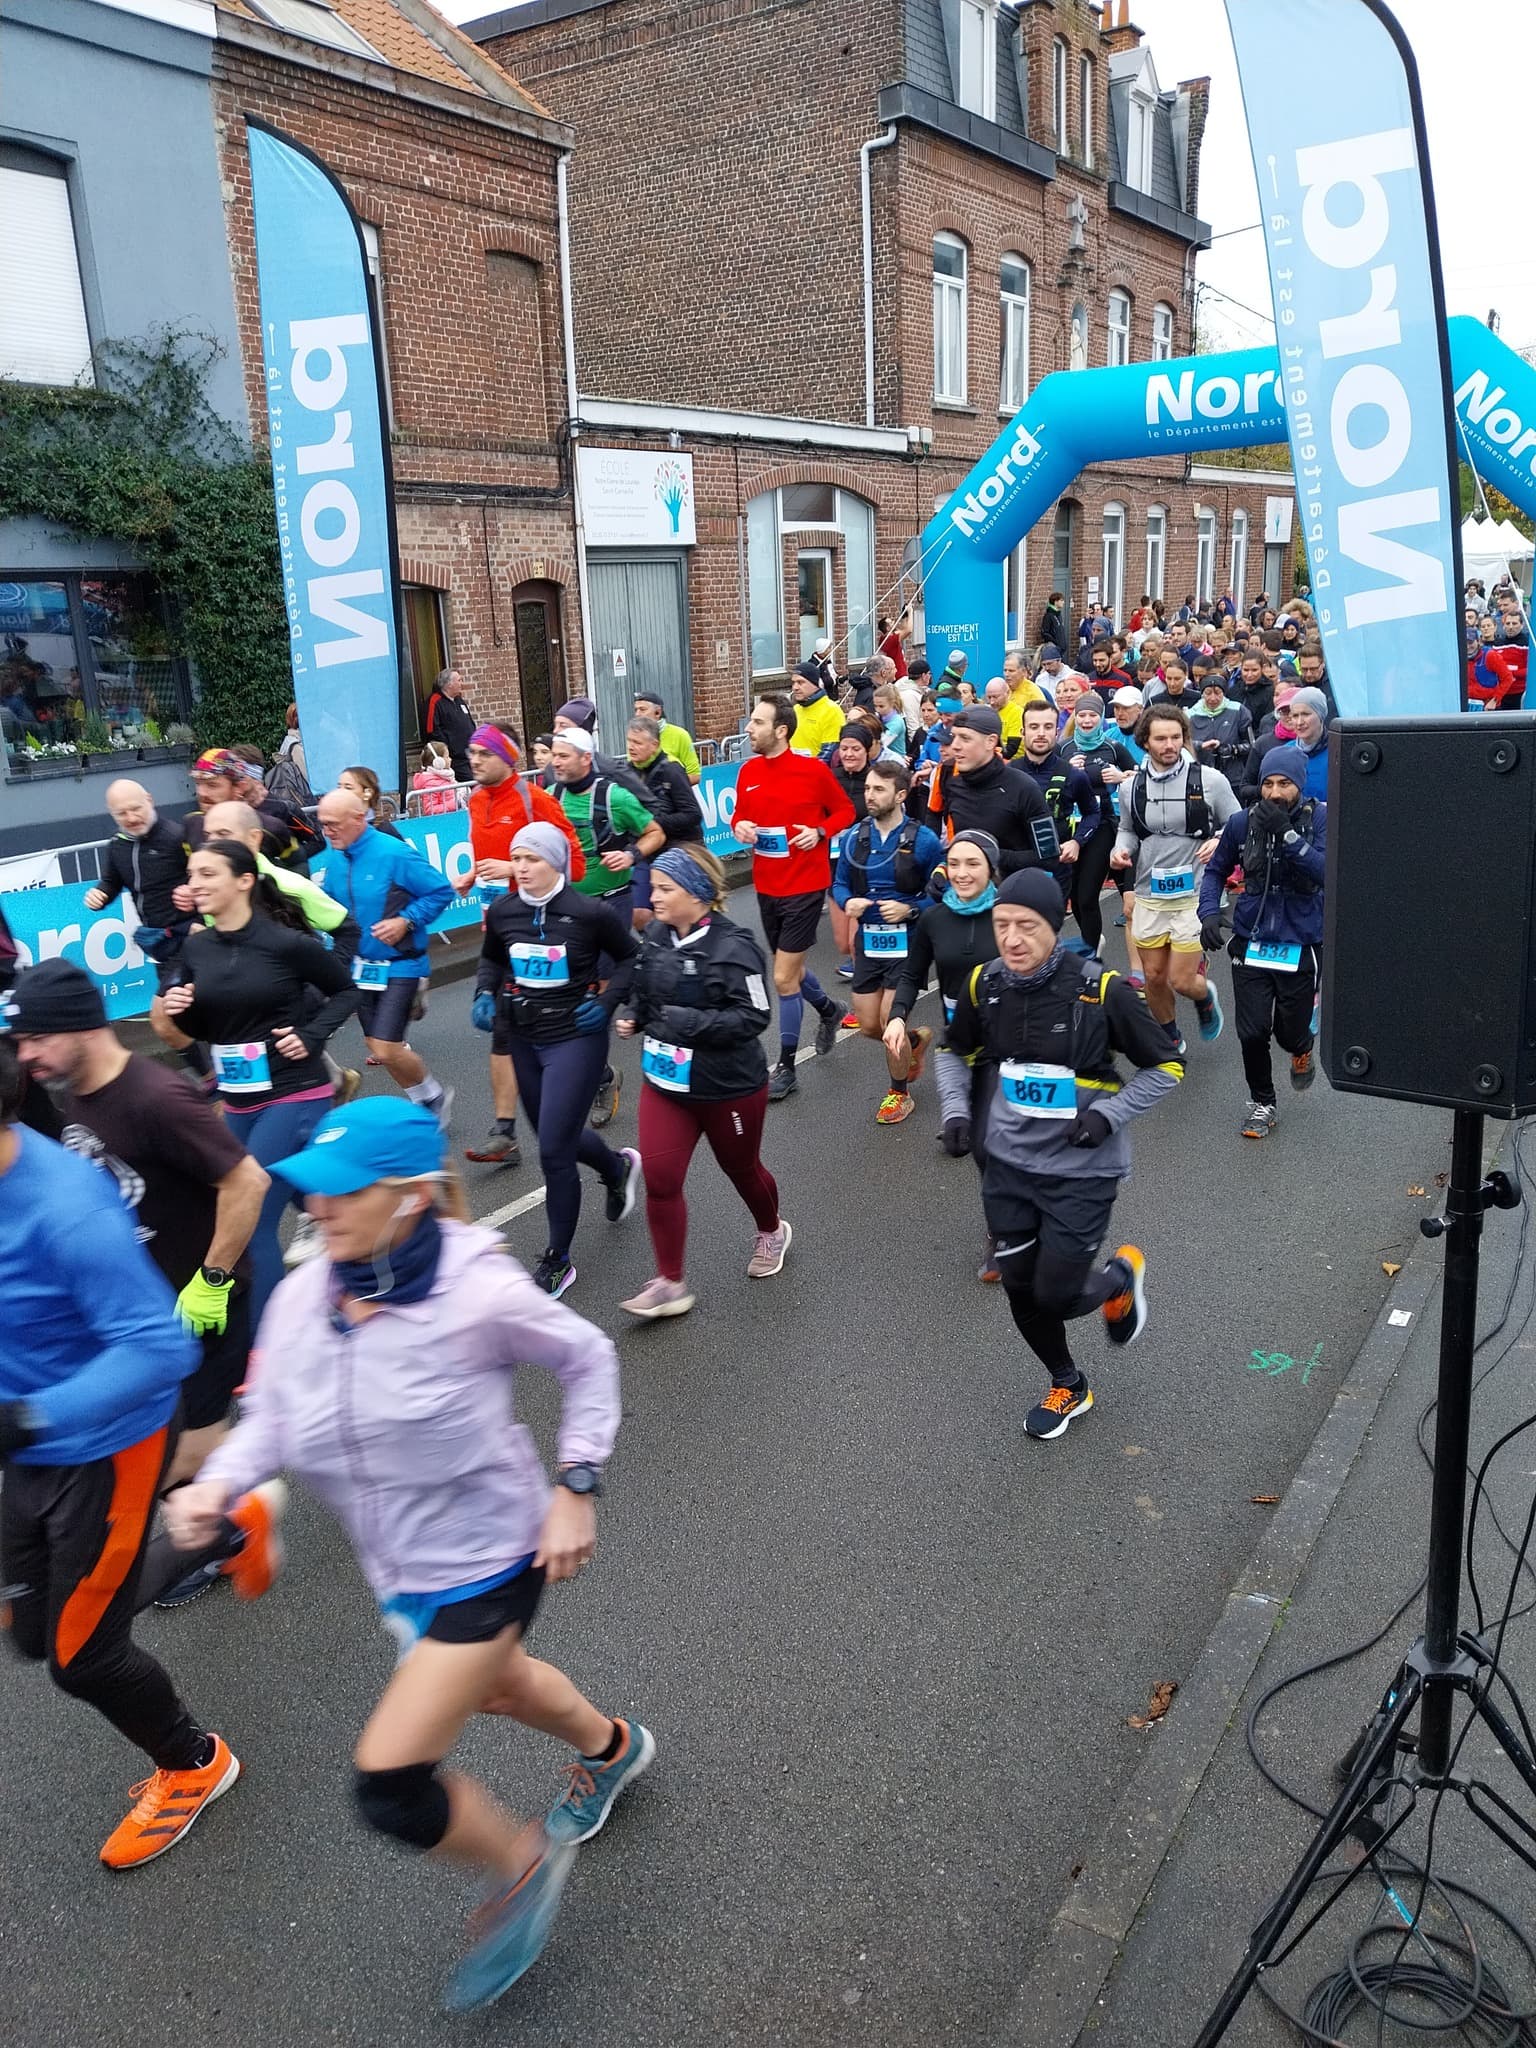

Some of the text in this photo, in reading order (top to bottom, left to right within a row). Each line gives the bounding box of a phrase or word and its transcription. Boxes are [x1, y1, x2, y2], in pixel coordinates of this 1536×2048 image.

[1148, 417, 1283, 439] le Département est
[1454, 368, 1536, 478] Nor
[951, 424, 1042, 538] Nord
[1508, 463, 1523, 478] est
[980, 486, 1021, 535] Département
[1021, 471, 1033, 485] est
[947, 633, 960, 643] EST
[1158, 877, 1185, 892] 694
[871, 935, 898, 950] 899
[522, 958, 554, 977] 737
[651, 1055, 678, 1078] 798
[1014, 1079, 1058, 1104] 867
